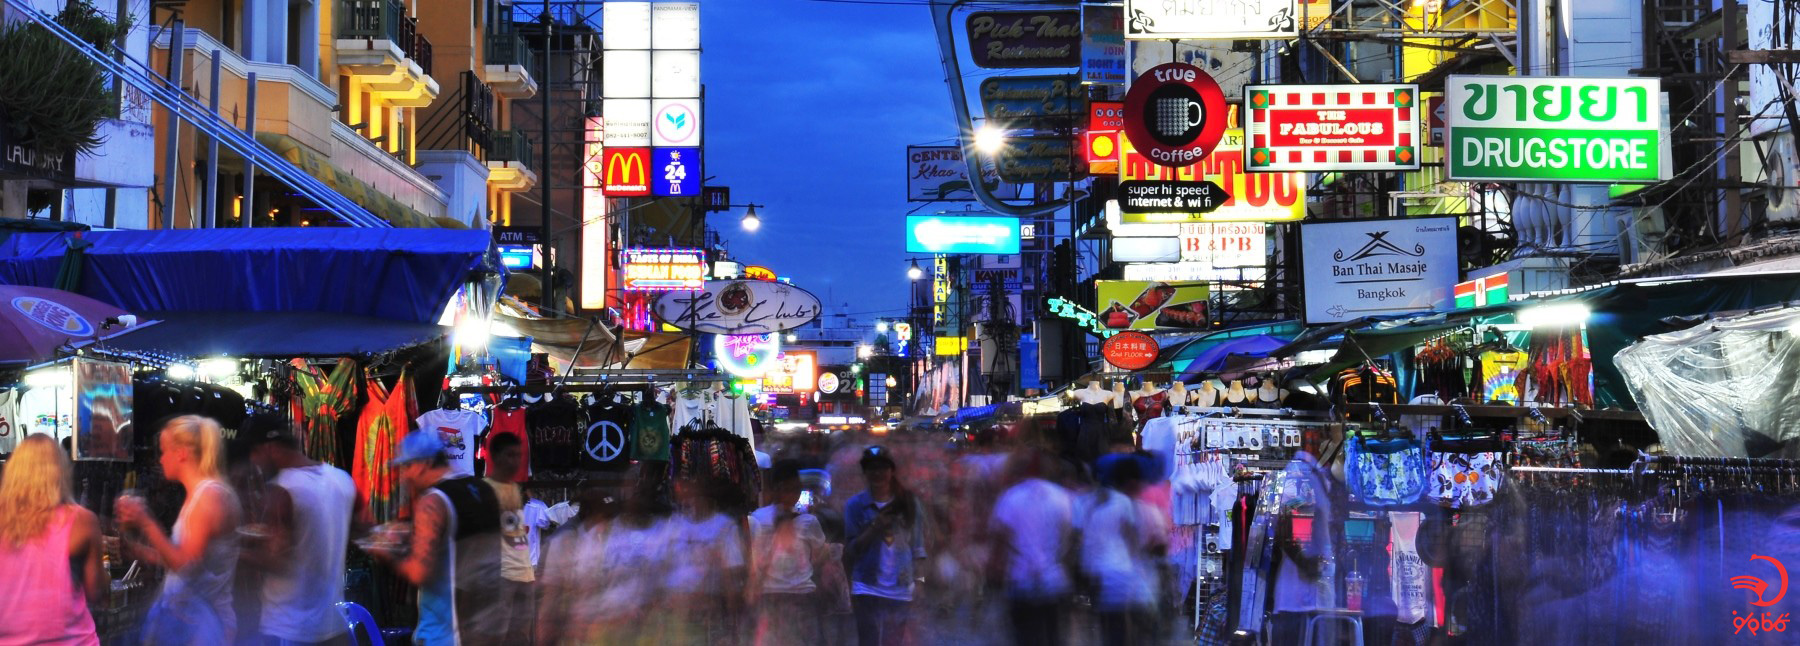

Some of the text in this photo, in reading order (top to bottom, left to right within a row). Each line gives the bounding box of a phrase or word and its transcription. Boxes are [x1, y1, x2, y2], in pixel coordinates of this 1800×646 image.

[987, 41, 1070, 59] Restaurant
[1155, 68, 1196, 83] true
[1463, 83, 1648, 123] ขายยา
[1317, 111, 1346, 120] THE
[1280, 122, 1384, 135] FABULOUS
[911, 151, 963, 163] CENTE
[1151, 146, 1203, 162] coffee
[1463, 137, 1648, 169] DRUGSTORE
[664, 165, 686, 180] 24
[912, 164, 957, 179] Khao
[1126, 151, 1298, 207] TTTOO
[1128, 184, 1210, 197] super hi speed
[1128, 196, 1212, 208] internet & wi fi
[500, 232, 523, 241] ATM
[1187, 237, 1200, 251] B
[1207, 239, 1218, 251] &
[1332, 260, 1427, 277] Ban Thai Masaje
[1357, 288, 1406, 301] Bangkok
[673, 292, 812, 324] The Club
[1115, 342, 1147, 351] 日本料理
[840, 371, 857, 379] OPE
